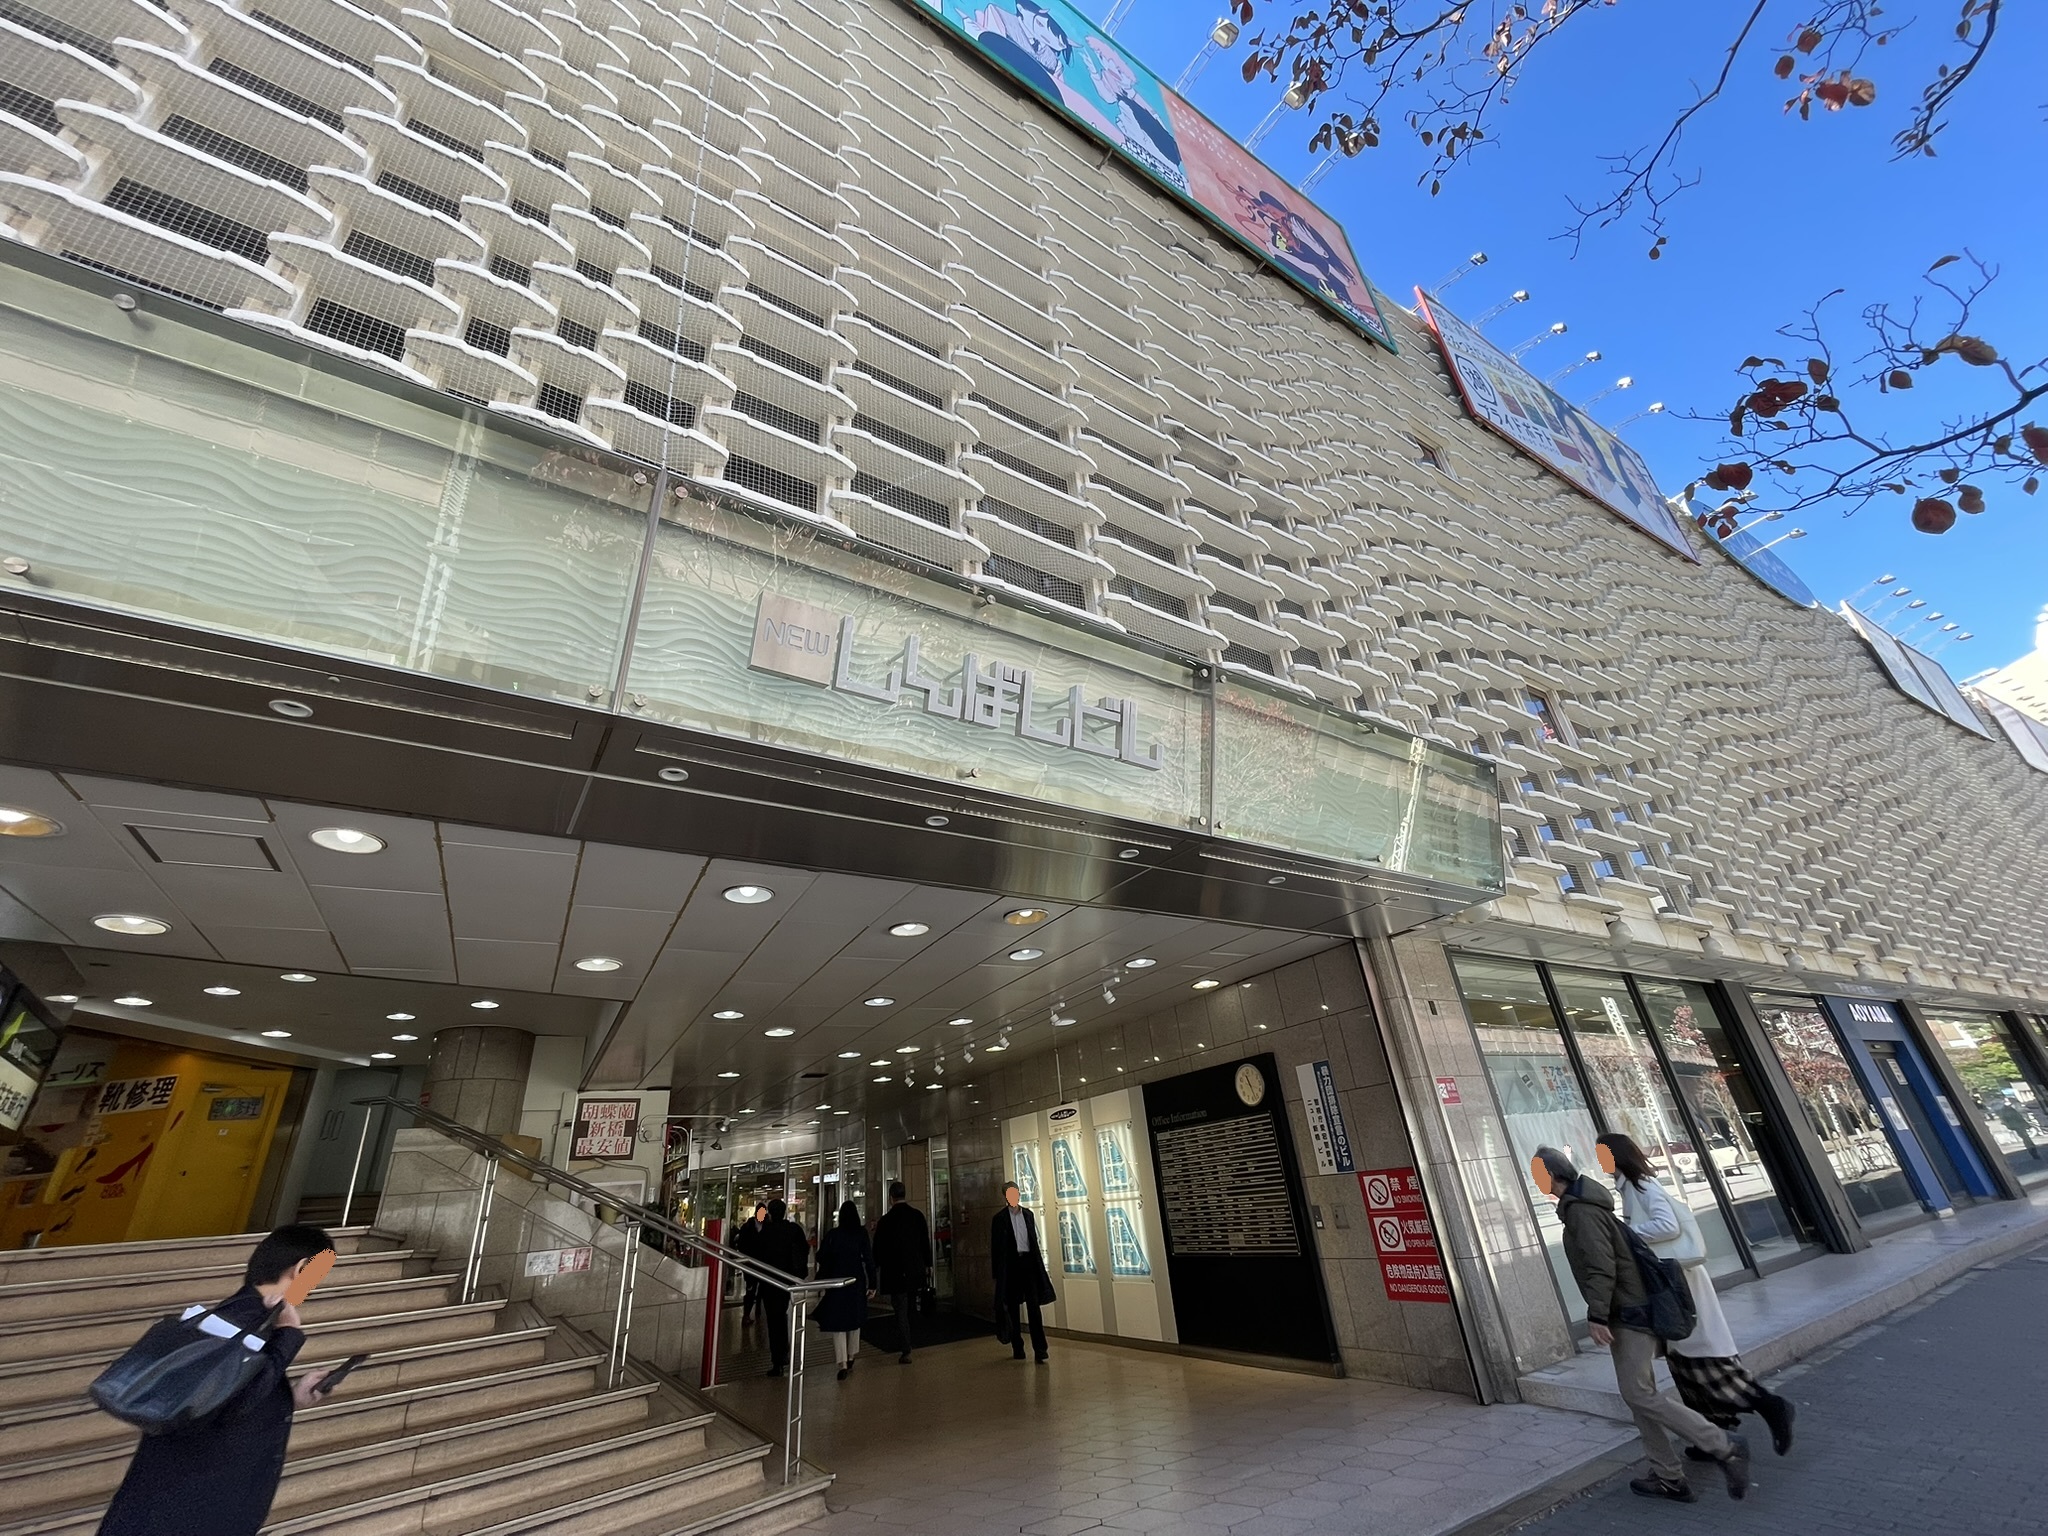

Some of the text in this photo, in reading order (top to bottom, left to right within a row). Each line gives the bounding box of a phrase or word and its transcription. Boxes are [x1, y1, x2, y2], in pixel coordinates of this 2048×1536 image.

[763, 614, 1163, 770] NEW しんばしビル
[1848, 1003, 1894, 1024] AOYAMA
[97, 1075, 178, 1114] 靴修理
[582, 1103, 636, 1120] 胡蝶蘭
[589, 1120, 625, 1138] 新橋
[576, 1137, 631, 1156] 最安値
[1400, 1219, 1432, 1234] 火気厳禁
[1389, 1283, 1398, 1292] NO
